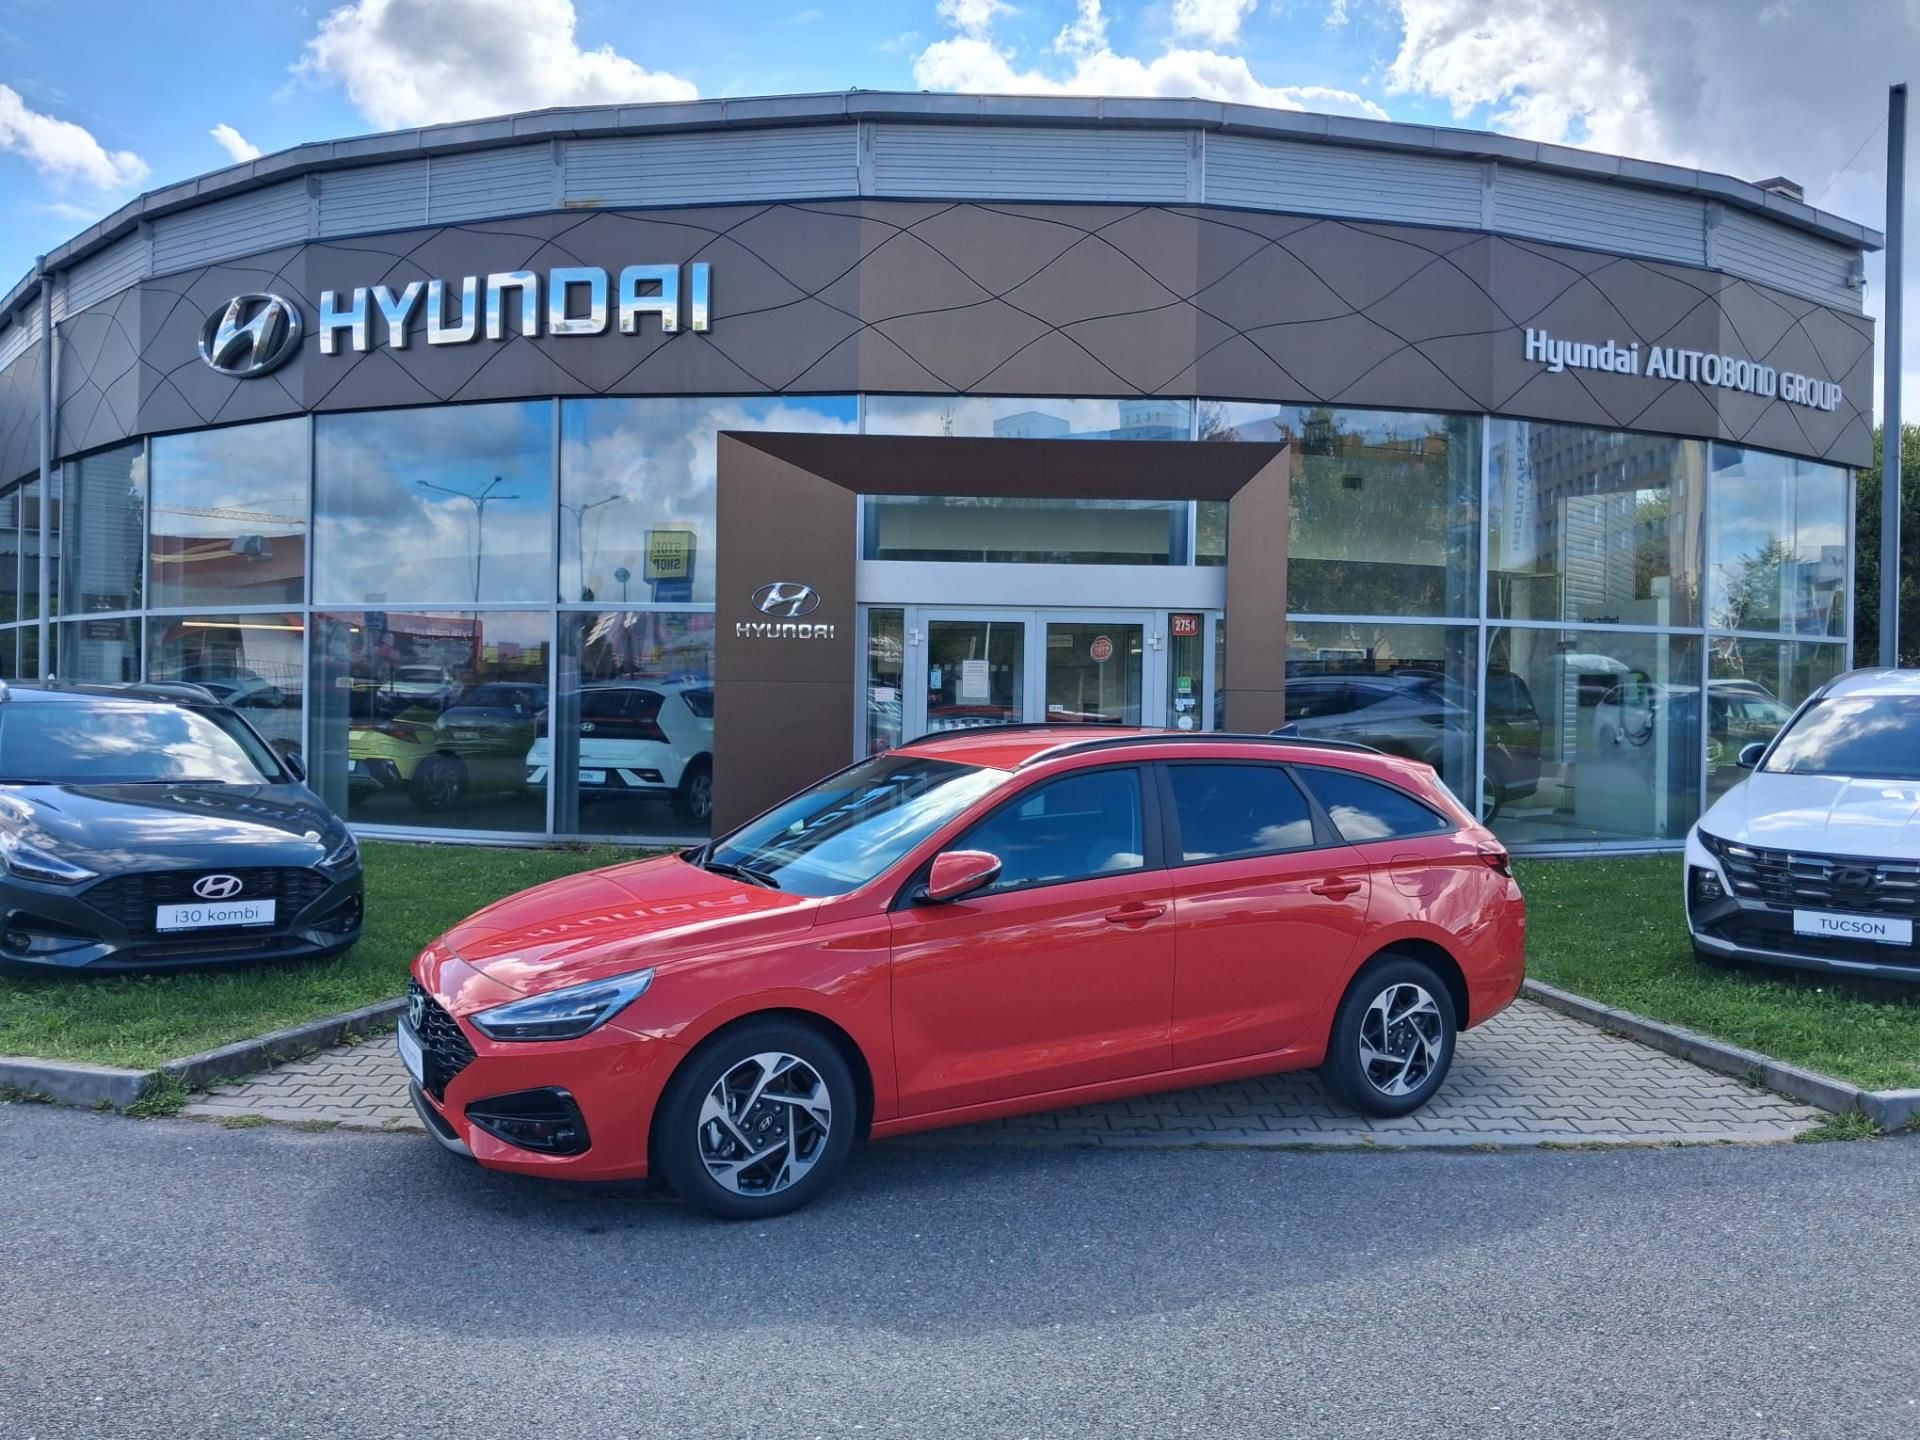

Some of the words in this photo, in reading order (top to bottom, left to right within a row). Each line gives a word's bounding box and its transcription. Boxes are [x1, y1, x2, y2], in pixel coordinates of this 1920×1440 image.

[320, 262, 711, 354] HYUNDAI
[1525, 328, 1639, 374] Hyundai
[1645, 346, 1776, 397] AUTOBOND
[1779, 371, 1842, 412] GROUP
[736, 622, 835, 639] HYUNDAI
[1175, 620, 1196, 632] 2754
[175, 910, 202, 923] i30
[207, 906, 260, 921] kombi
[1819, 918, 1885, 935] TUCSON
